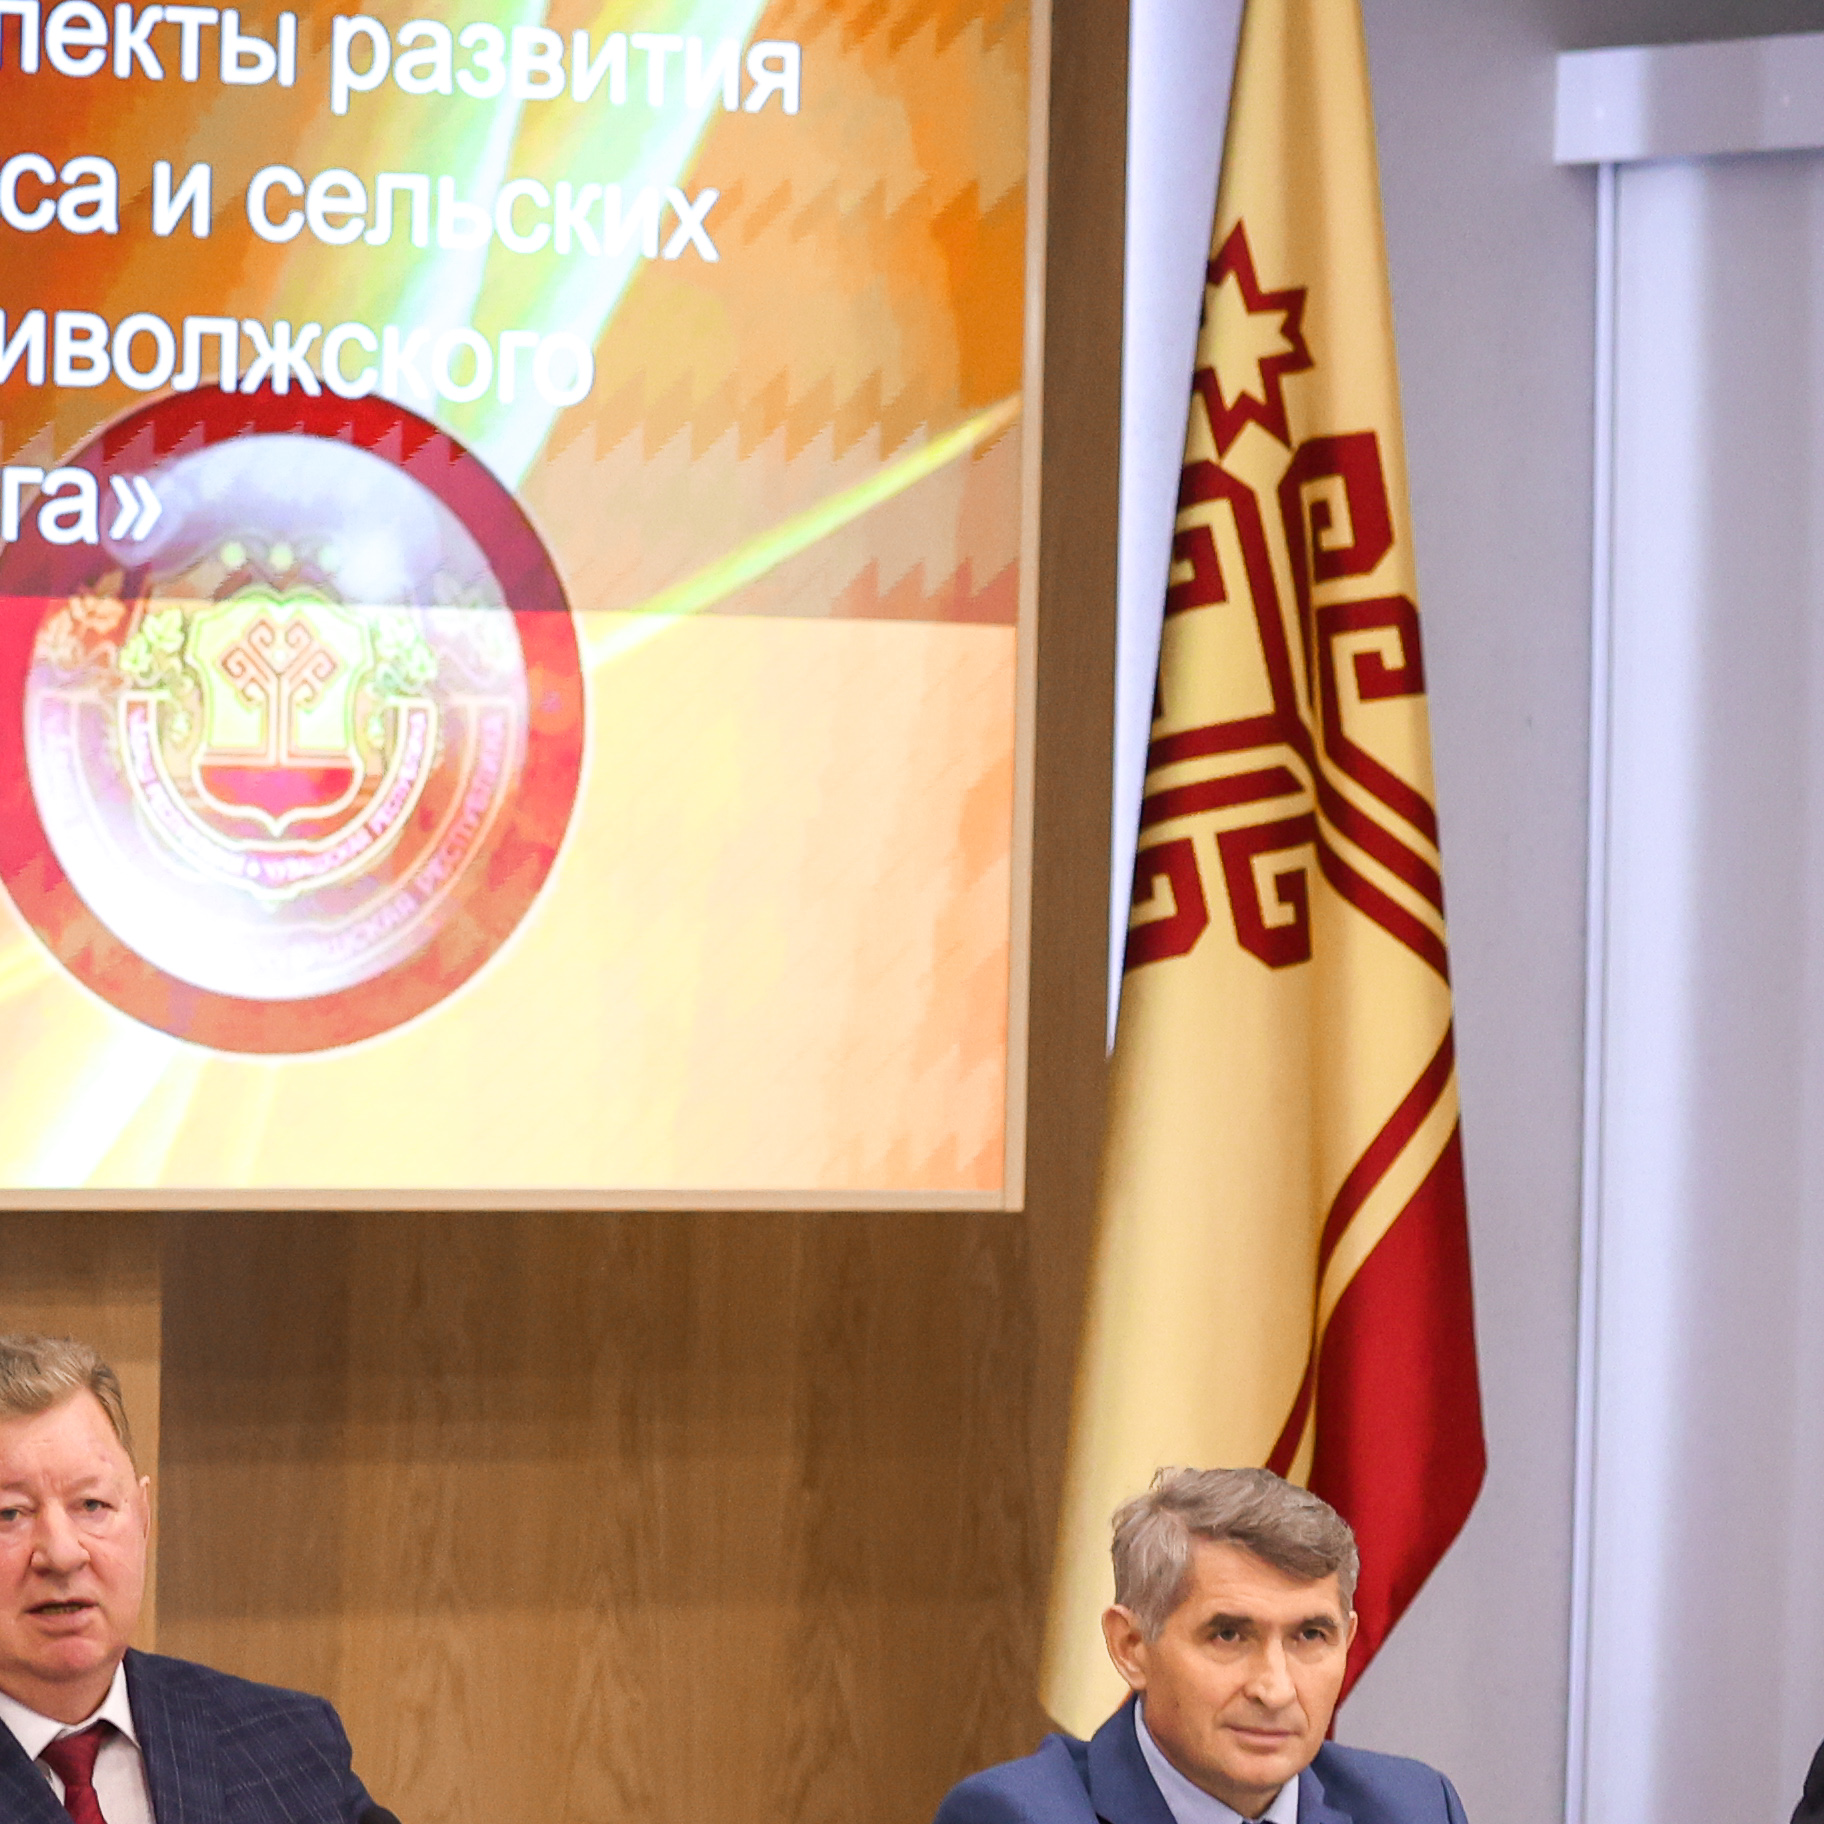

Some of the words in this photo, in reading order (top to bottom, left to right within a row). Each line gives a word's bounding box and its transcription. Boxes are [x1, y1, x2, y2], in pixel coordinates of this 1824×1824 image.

[330, 13, 802, 115] развития
[152, 160, 213, 239] и
[245, 162, 721, 262] сельских
